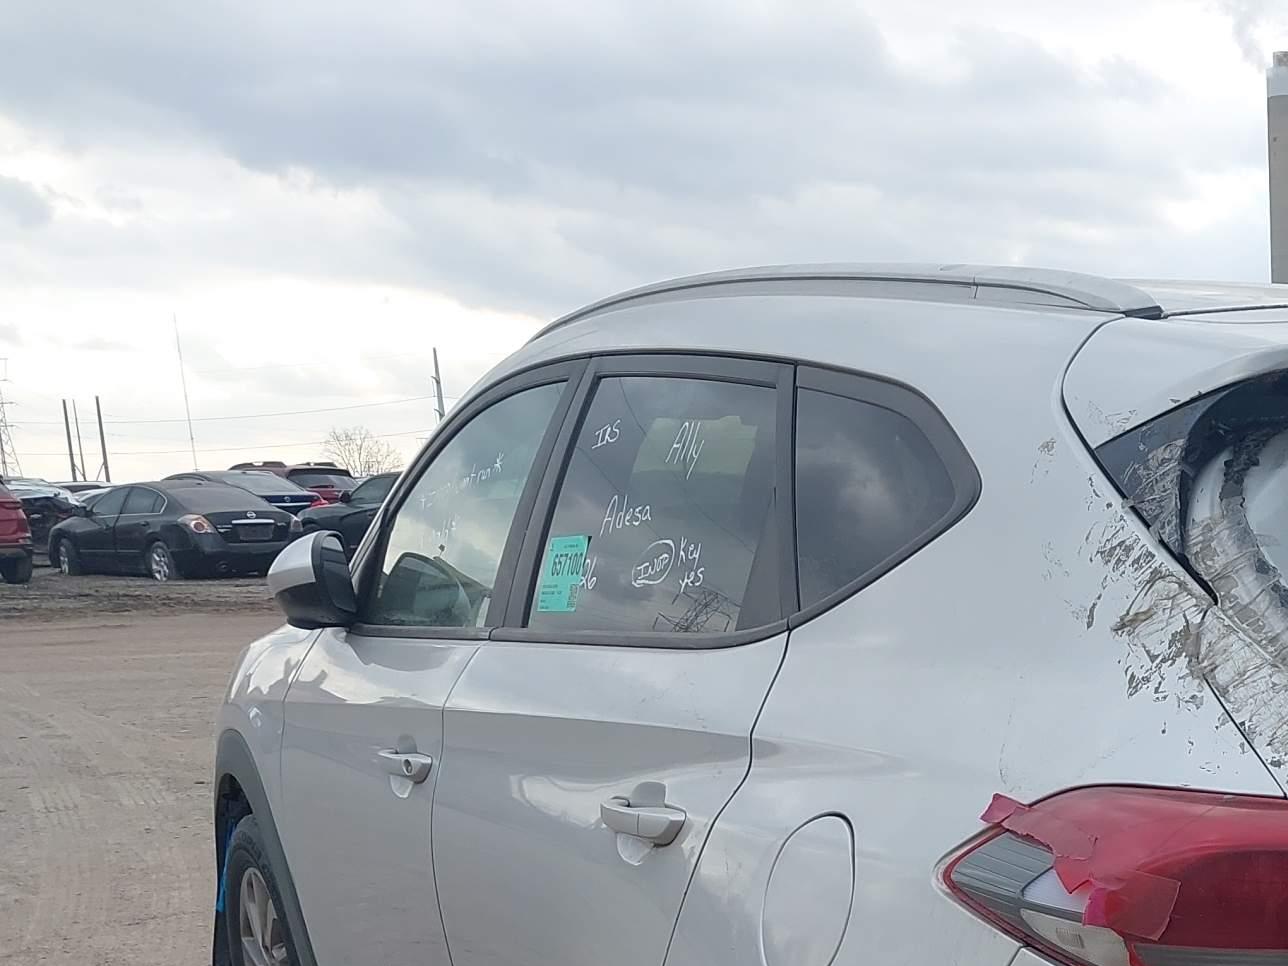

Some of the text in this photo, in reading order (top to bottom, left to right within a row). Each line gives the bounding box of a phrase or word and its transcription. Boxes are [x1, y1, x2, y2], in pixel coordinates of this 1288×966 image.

[665, 421, 705, 480] Ally
[600, 494, 652, 537] Adesa
[551, 552, 584, 577] 657100
